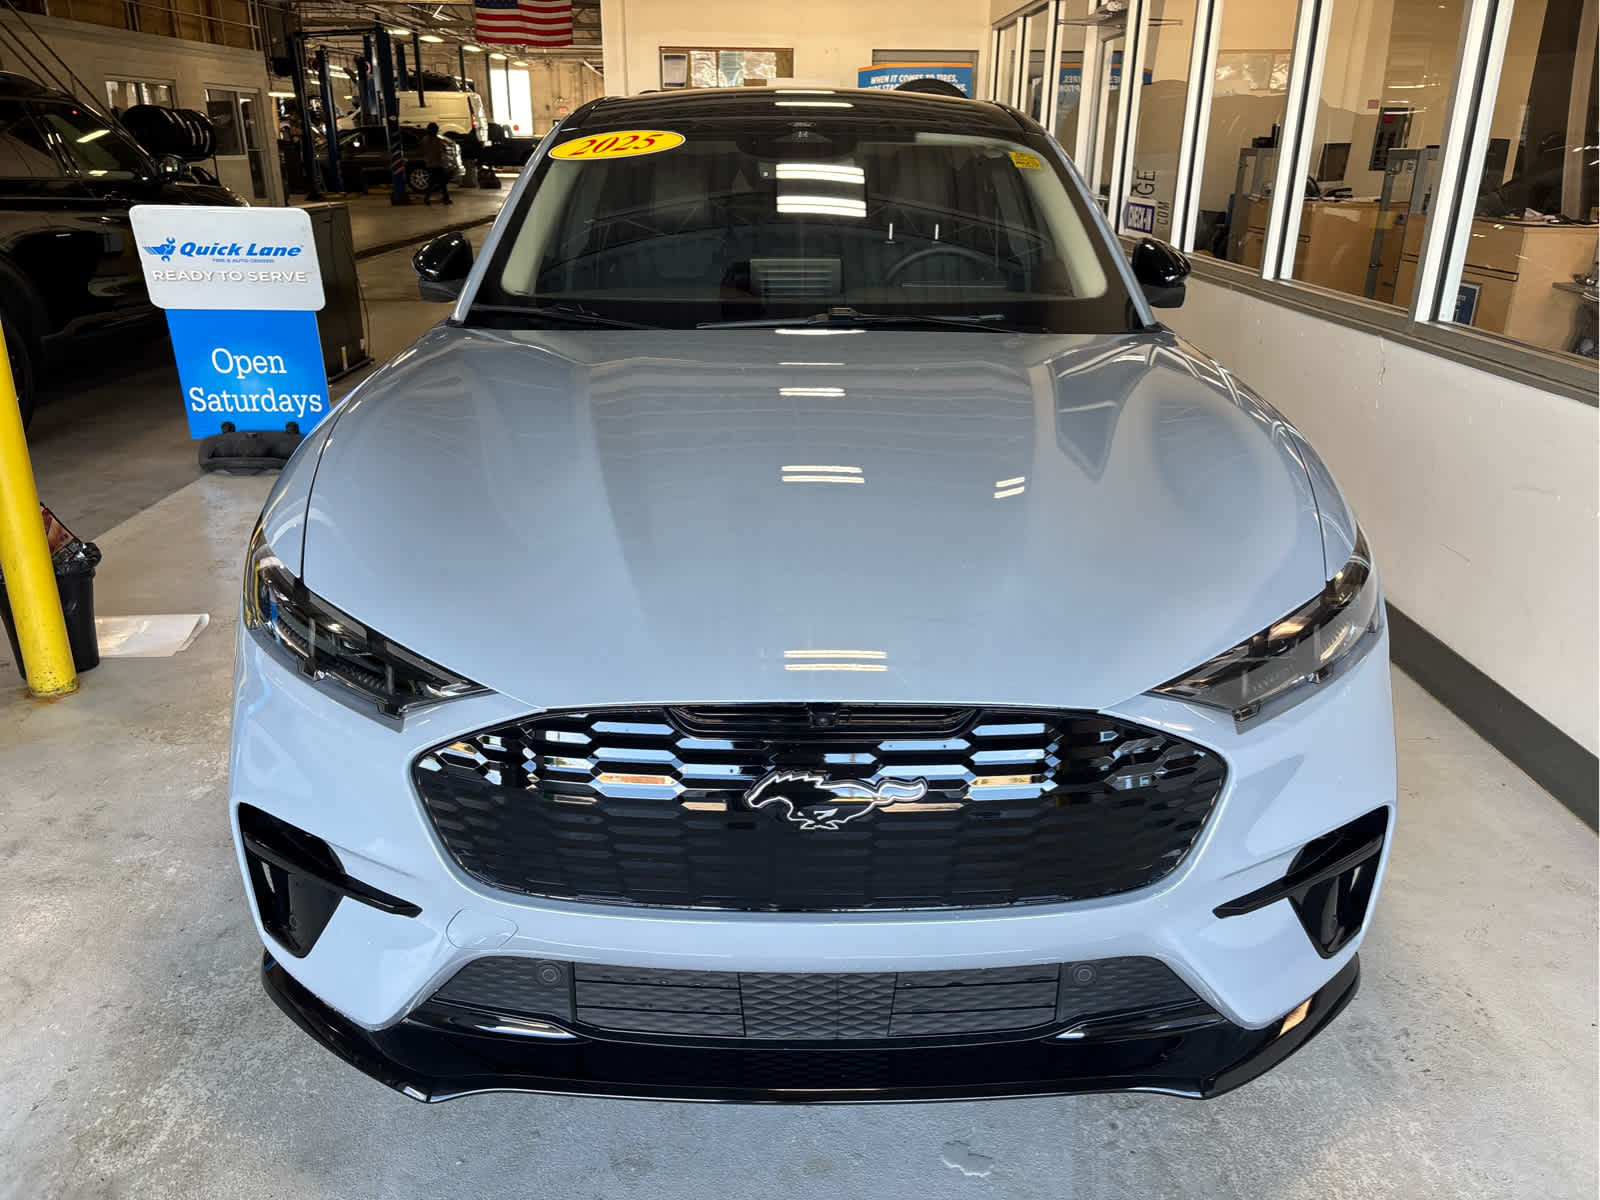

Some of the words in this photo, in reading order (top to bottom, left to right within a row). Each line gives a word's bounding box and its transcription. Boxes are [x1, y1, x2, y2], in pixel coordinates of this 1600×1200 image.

[870, 75, 890, 85] WHEN
[890, 74, 899, 83] IT
[567, 134, 665, 156] 2025
[180, 242, 243, 257] Quick
[246, 243, 302, 257] Lane
[152, 271, 216, 282] READY
[218, 271, 243, 282] TO
[247, 271, 308, 283] SERVE
[211, 347, 287, 379] Open
[189, 386, 323, 418] Saturdays
